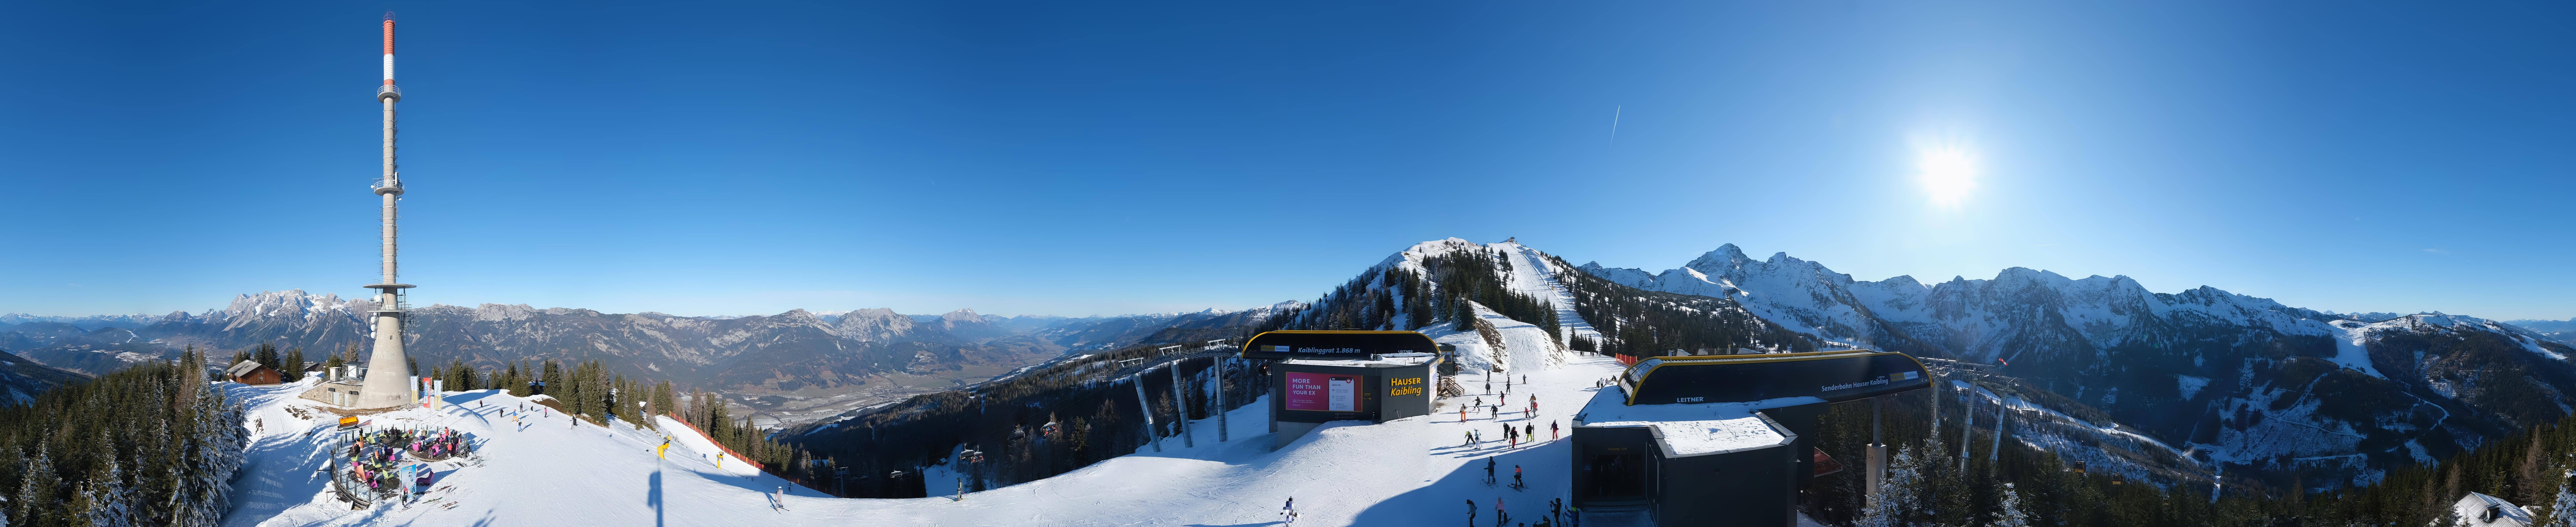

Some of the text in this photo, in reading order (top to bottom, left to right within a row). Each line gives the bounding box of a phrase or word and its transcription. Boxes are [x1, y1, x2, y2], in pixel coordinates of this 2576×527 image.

[1391, 378, 1421, 386] HAUSER
[1391, 386, 1421, 396] Kaibling
[1822, 383, 1852, 392] Senderbahn
